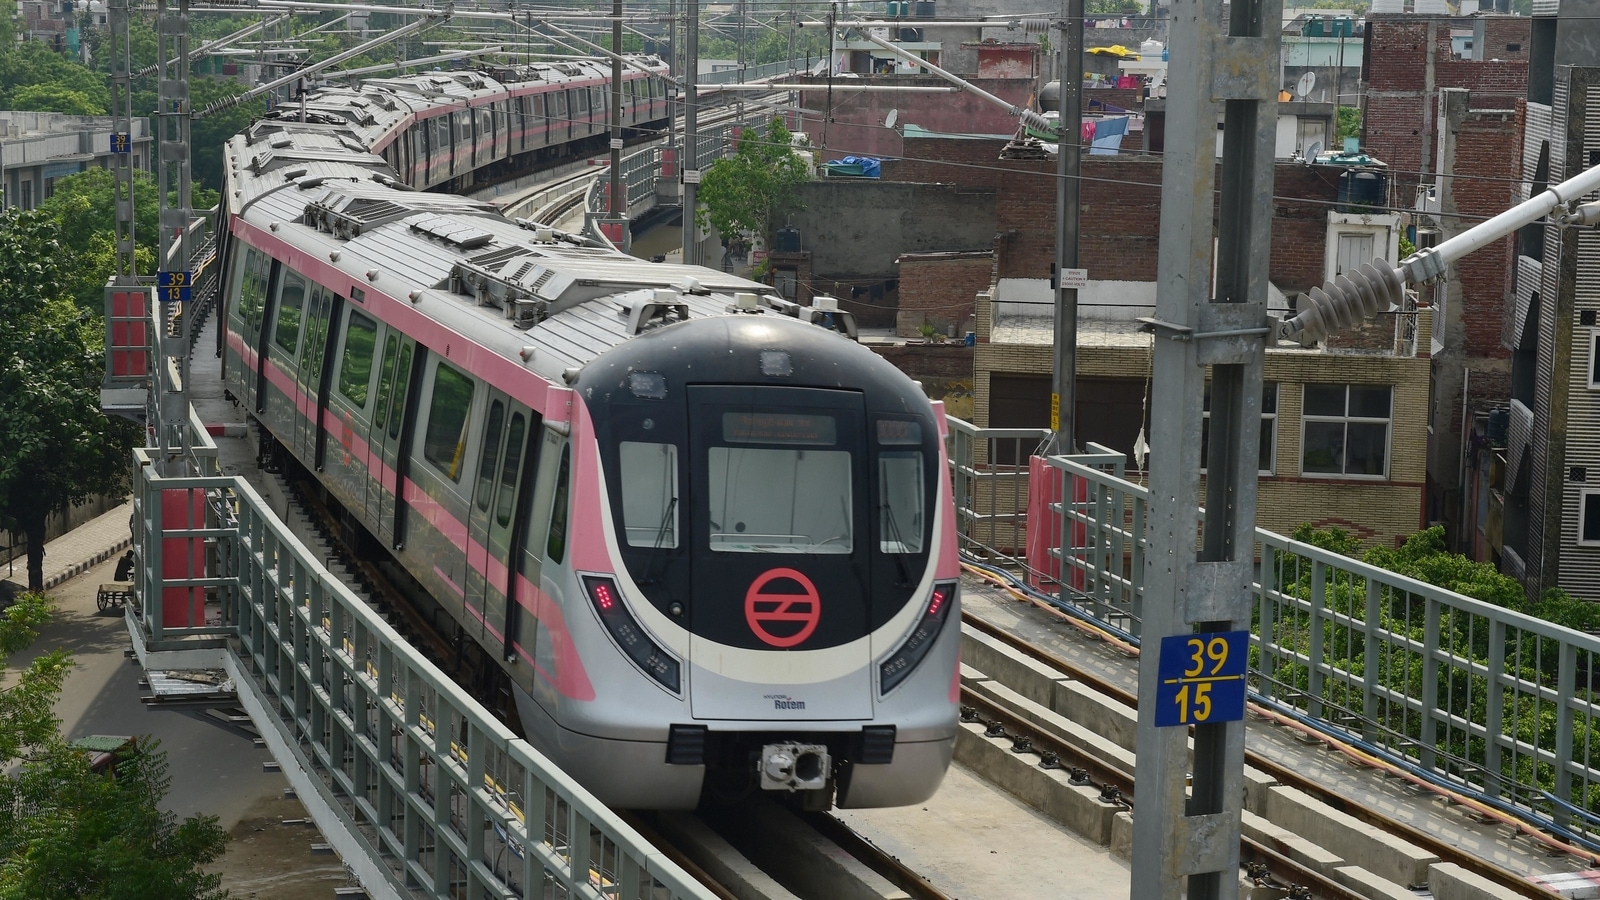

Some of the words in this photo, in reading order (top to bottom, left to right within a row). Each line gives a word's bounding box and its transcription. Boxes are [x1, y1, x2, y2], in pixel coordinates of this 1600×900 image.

[168, 273, 184, 286] 39
[168, 288, 180, 300] 13
[1185, 637, 1229, 677] 39
[774, 700, 806, 710] Rotem
[1175, 683, 1212, 723] 15
